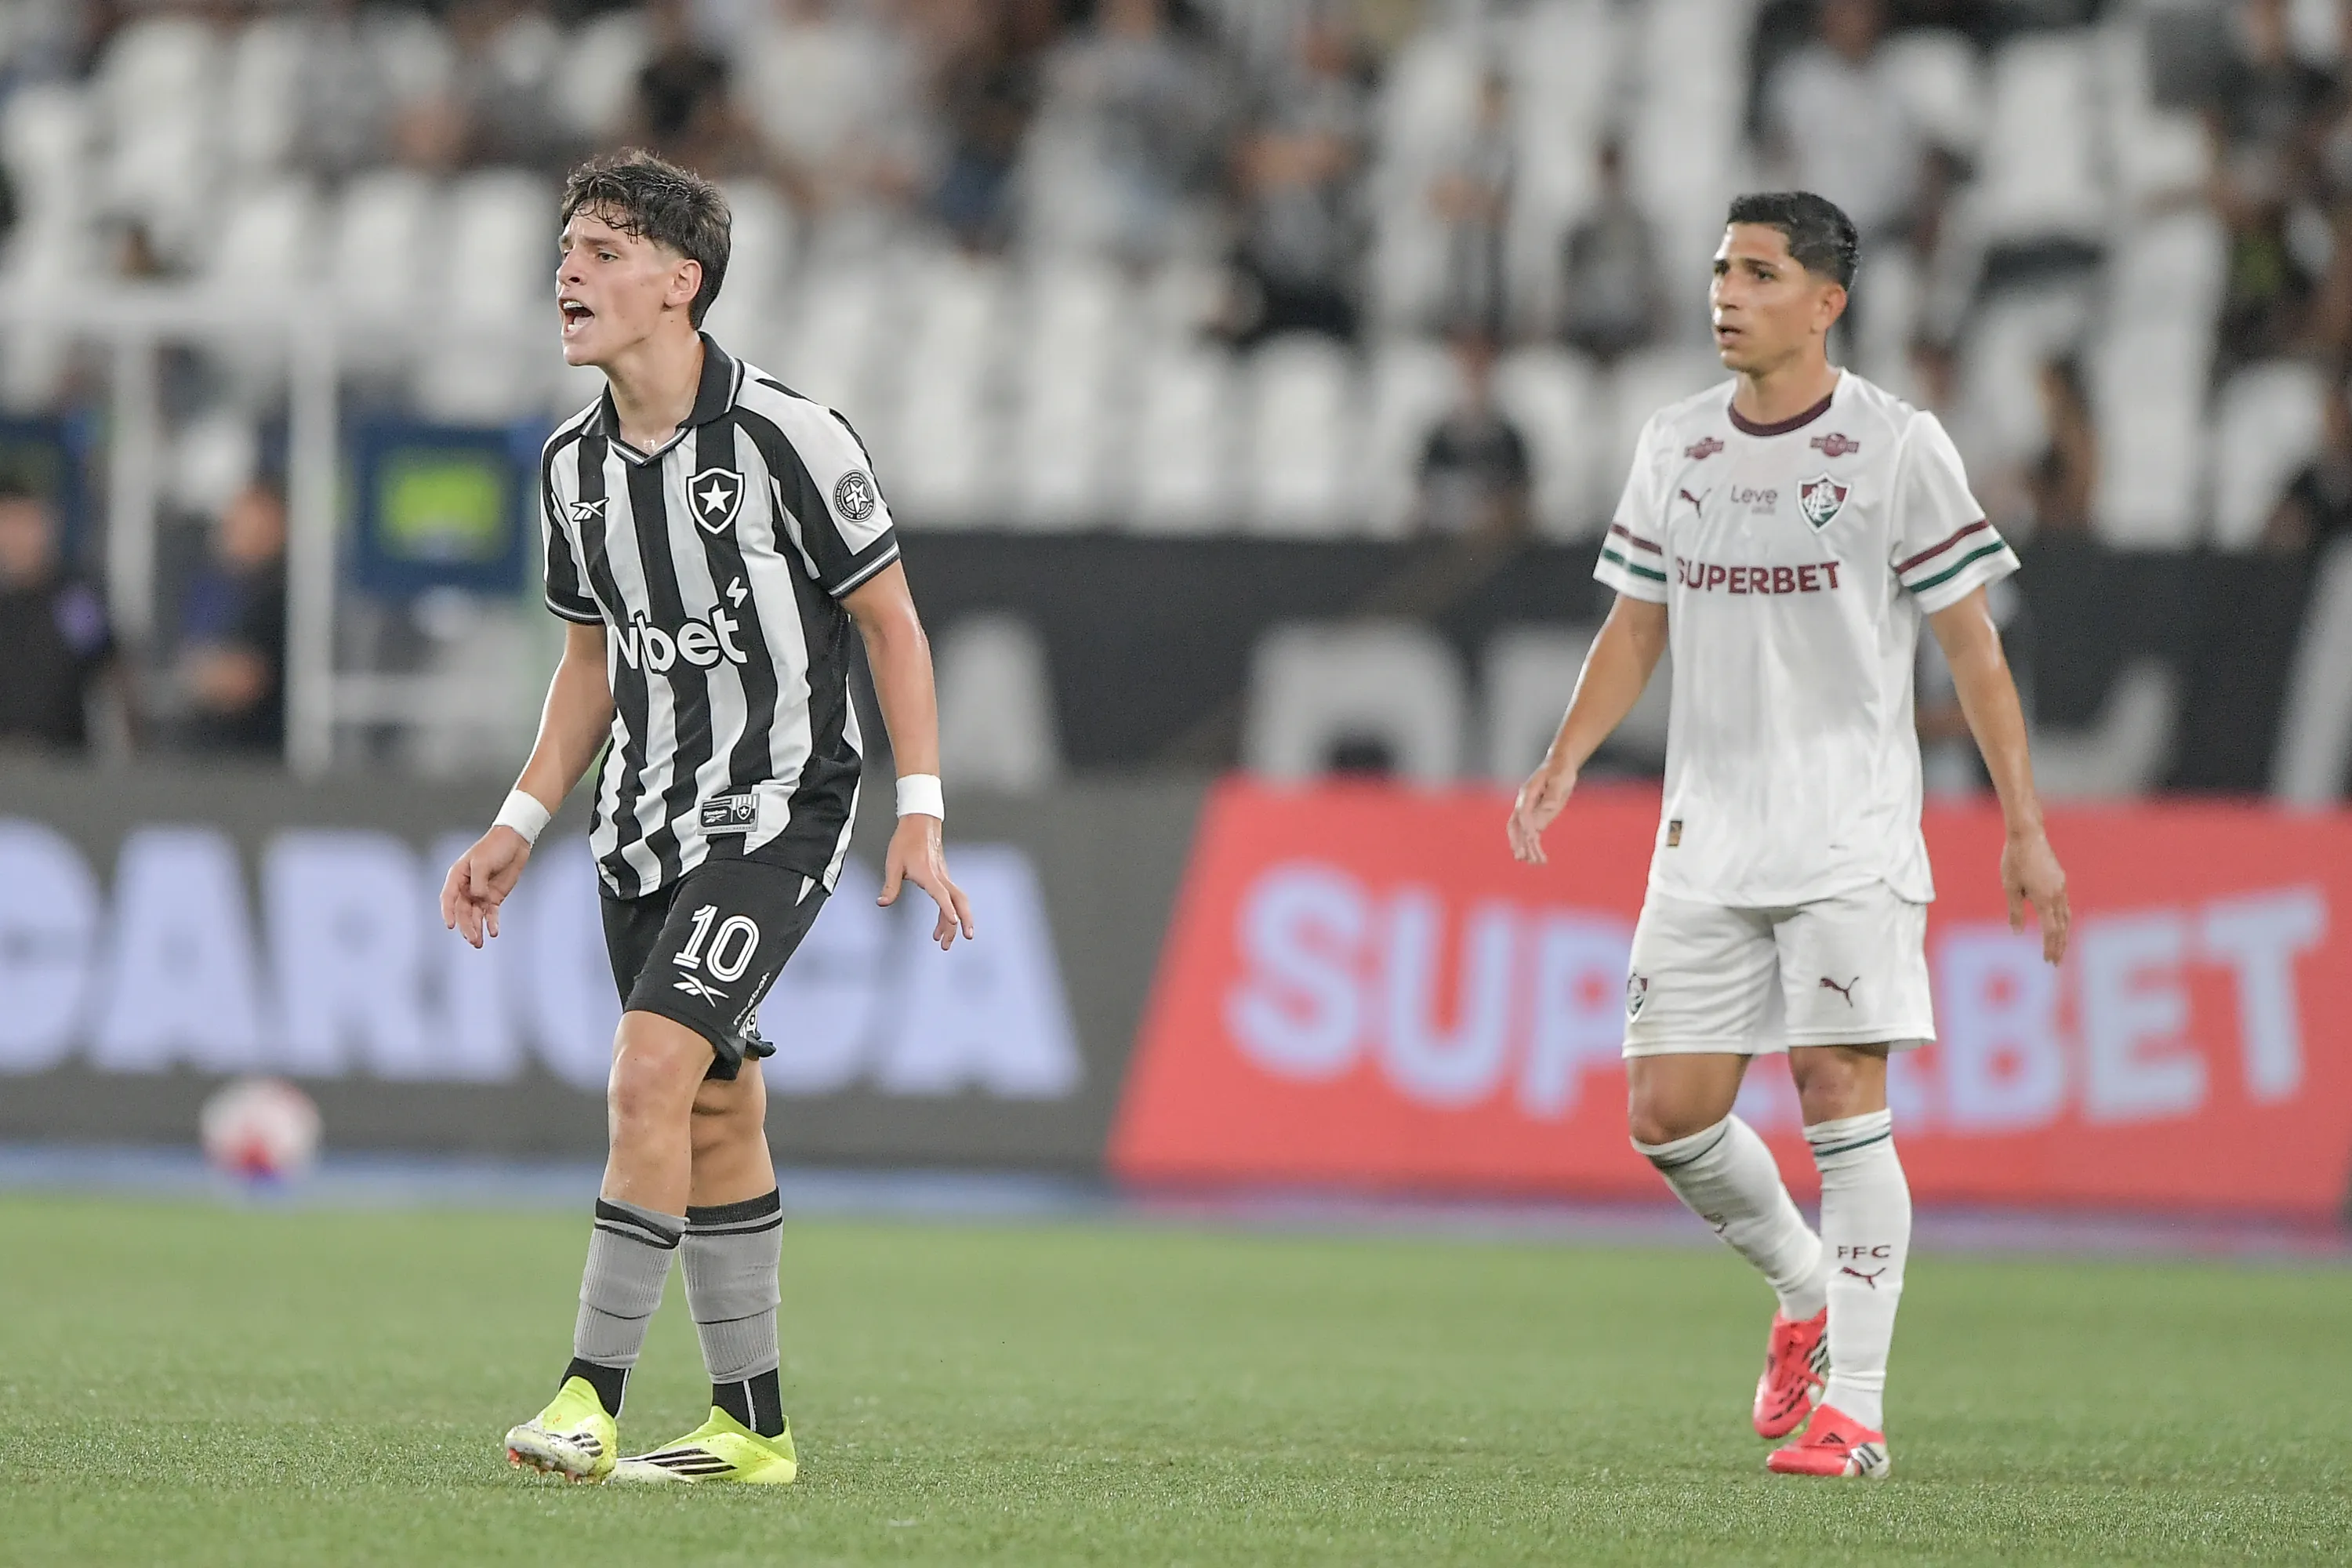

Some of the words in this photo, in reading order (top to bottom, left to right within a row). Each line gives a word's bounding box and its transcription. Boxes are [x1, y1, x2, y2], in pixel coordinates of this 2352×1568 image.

[1730, 484, 1778, 504] Leve
[1676, 555, 1840, 594] SUPERBET
[672, 903, 760, 983] 10
[1225, 861, 2330, 1133] SUPBET
